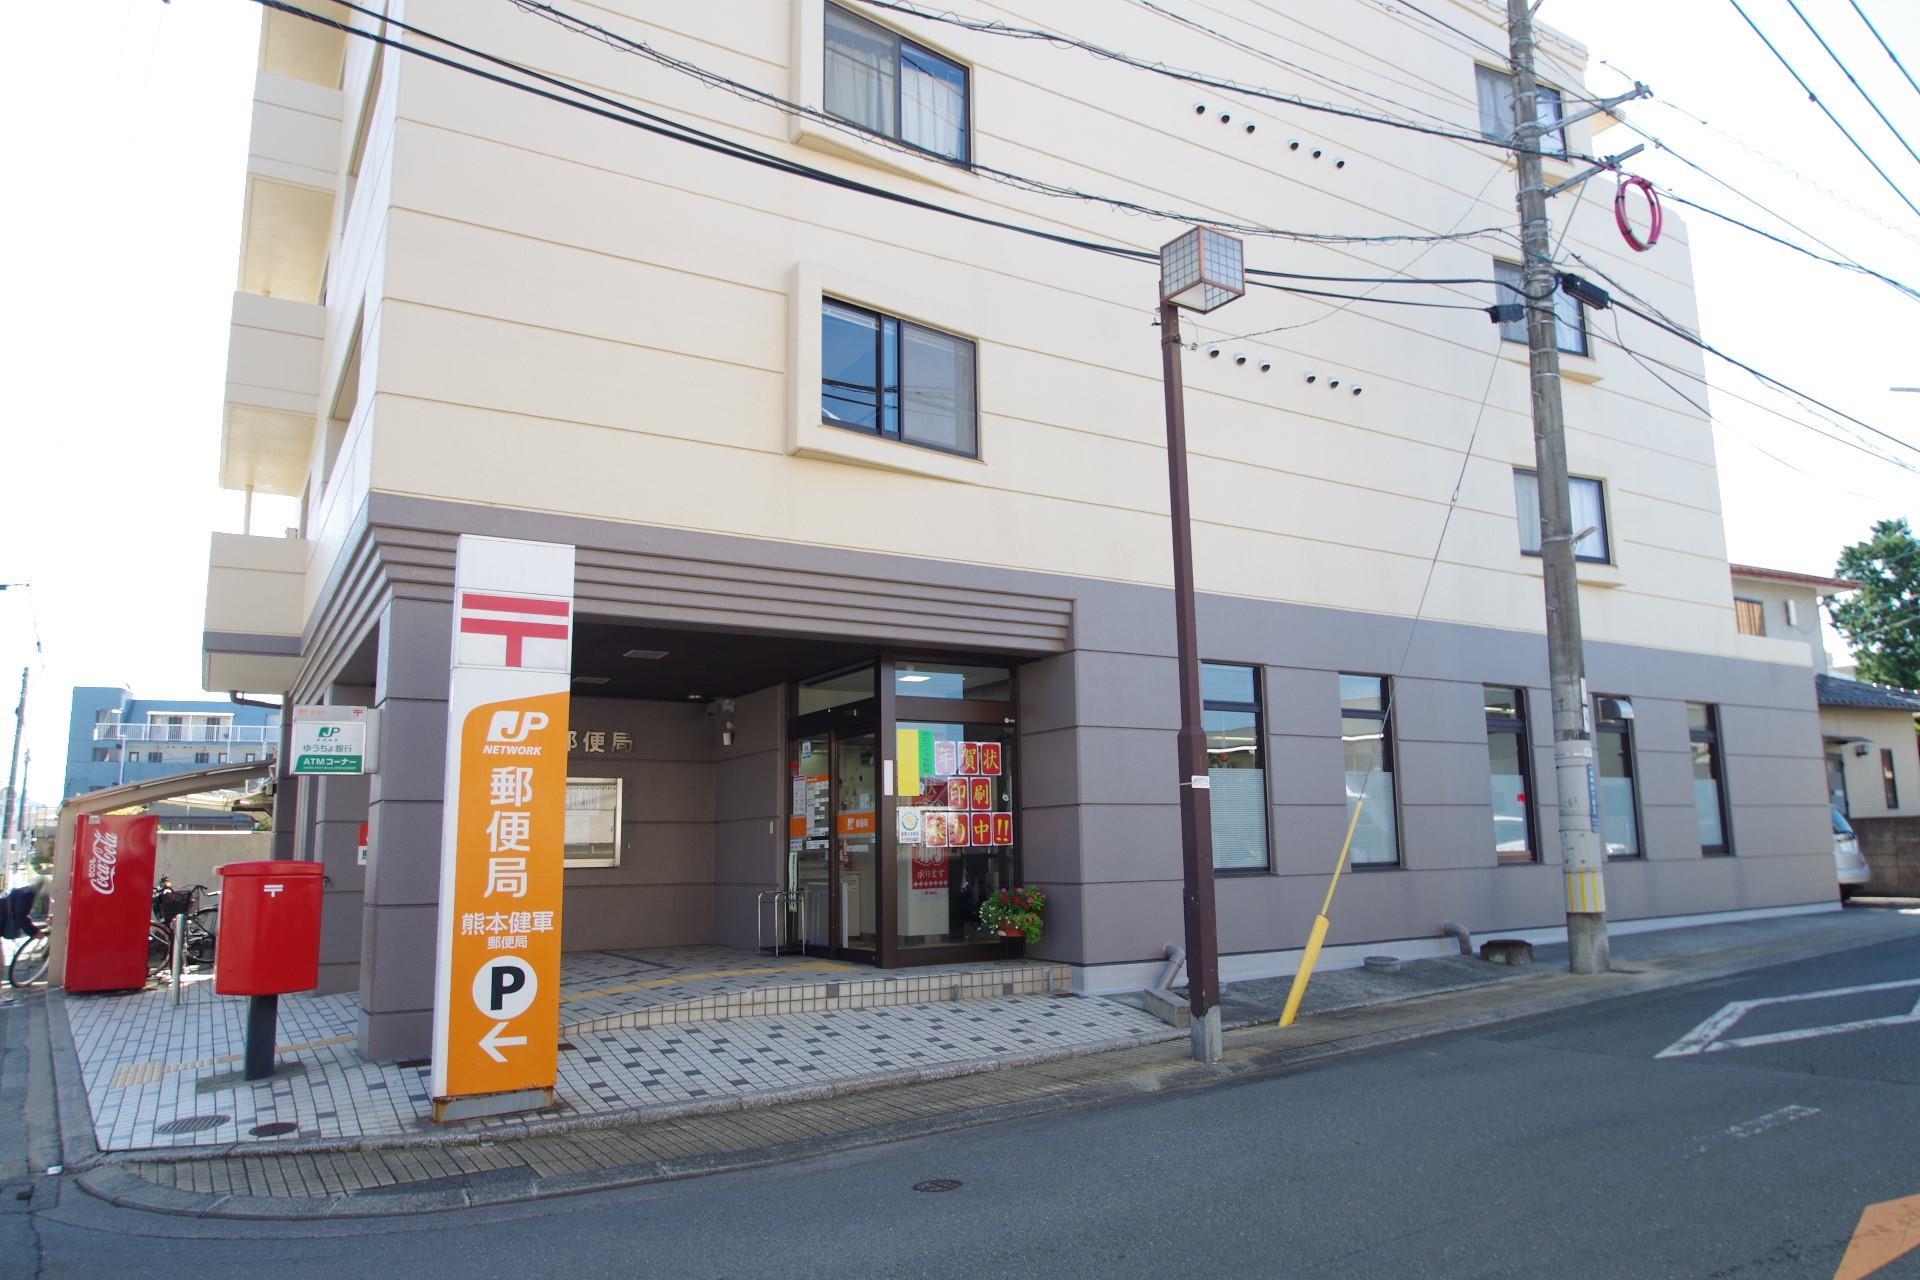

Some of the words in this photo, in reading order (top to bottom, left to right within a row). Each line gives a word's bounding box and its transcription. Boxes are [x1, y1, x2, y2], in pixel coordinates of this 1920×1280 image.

[303, 744, 353, 753] ゆうちょ銀行
[483, 745, 542, 756] NETWORK
[940, 745, 999, 771] 年賀状
[303, 757, 357, 766] ATMコーナー
[951, 783, 989, 806] 印刷
[484, 766, 534, 898] 郵便局
[461, 911, 554, 935] 熊本健軍
[487, 936, 528, 949] 郵便局
[490, 966, 526, 1011] P
